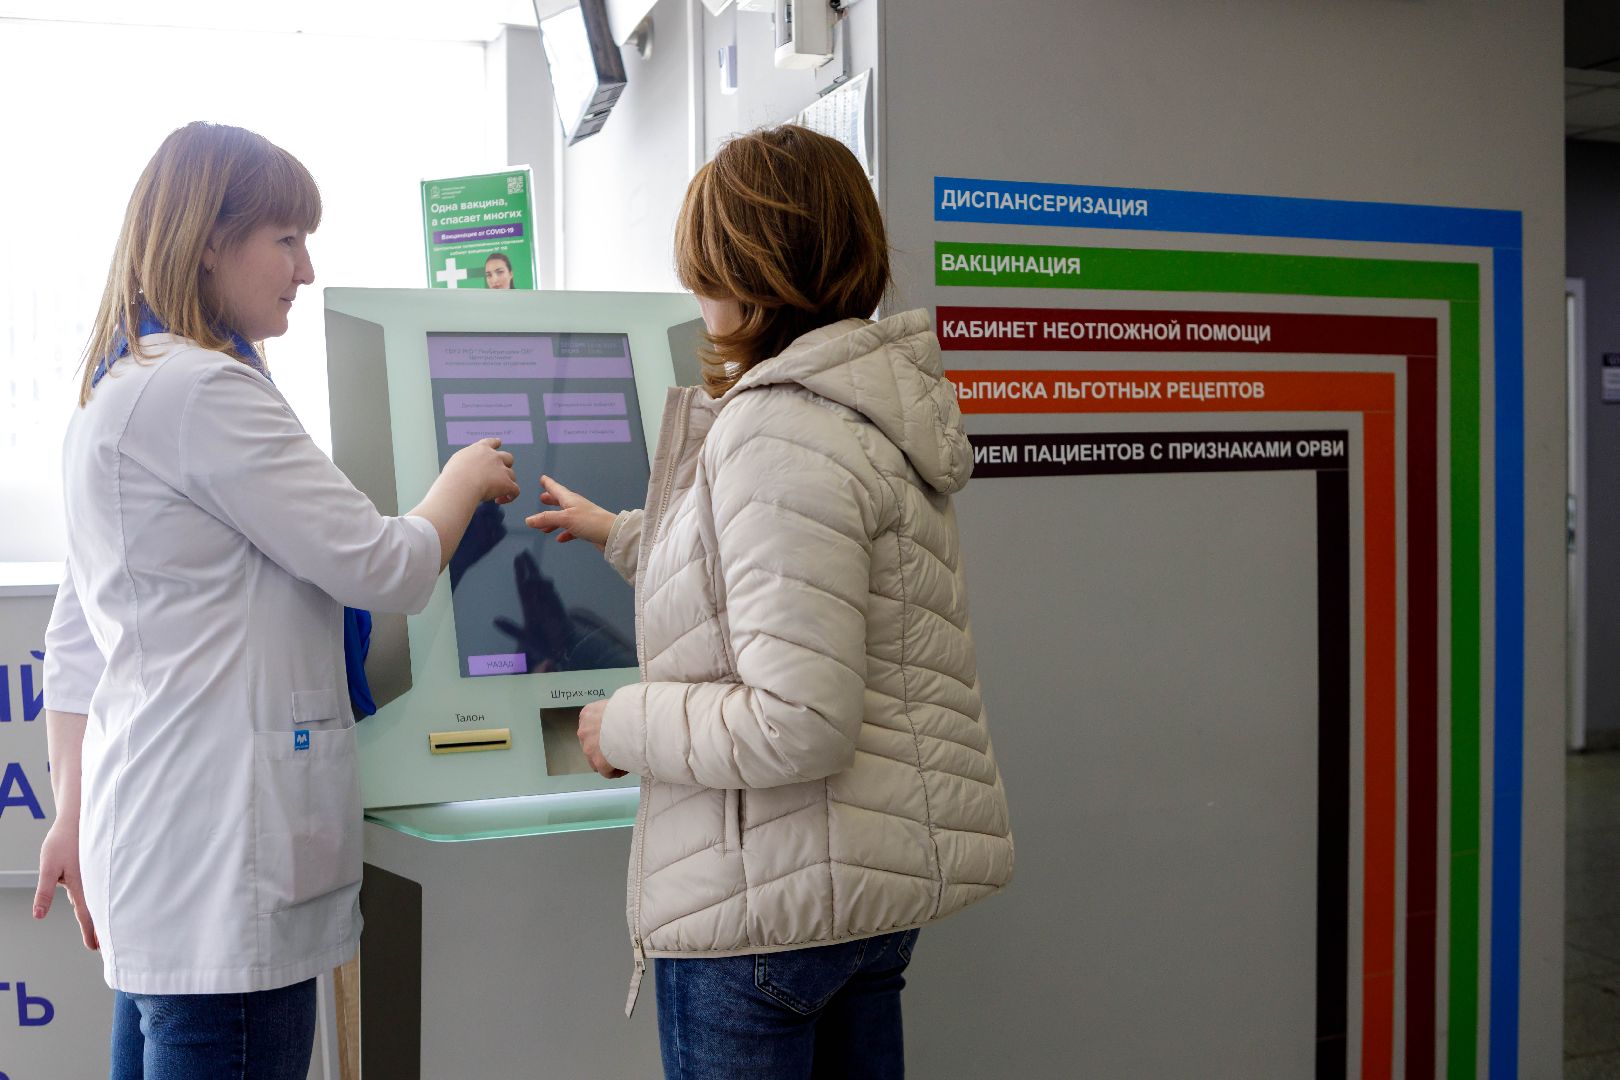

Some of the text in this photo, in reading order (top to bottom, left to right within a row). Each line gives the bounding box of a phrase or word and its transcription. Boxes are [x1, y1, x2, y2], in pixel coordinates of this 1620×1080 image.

[431, 198, 508, 214] Одна вакцина,
[941, 189, 1148, 218] ДИСПАНСЕРИЗАЦИЯ
[440, 214, 480, 225] спасает
[483, 210, 522, 220] многих
[485, 227, 514, 236] COVID-19
[941, 253, 1081, 277] ВАКЦИНАЦИЯ
[942, 320, 1271, 344] КАБИНЕТ НЕОТЛОЖНОЙ ПОМОЩИ
[954, 381, 1265, 402] ЫПИСКА ЛЬГОТНЫХ РЕЦЕПТОВ
[974, 440, 1344, 465] ИЕМ ПАЦИЕНТОВ С ПРИЗНАКАМИ ОРВИ
[486, 660, 515, 669] НАЗАД
[551, 688, 606, 700] Штрих-код
[455, 712, 485, 723] Талон
